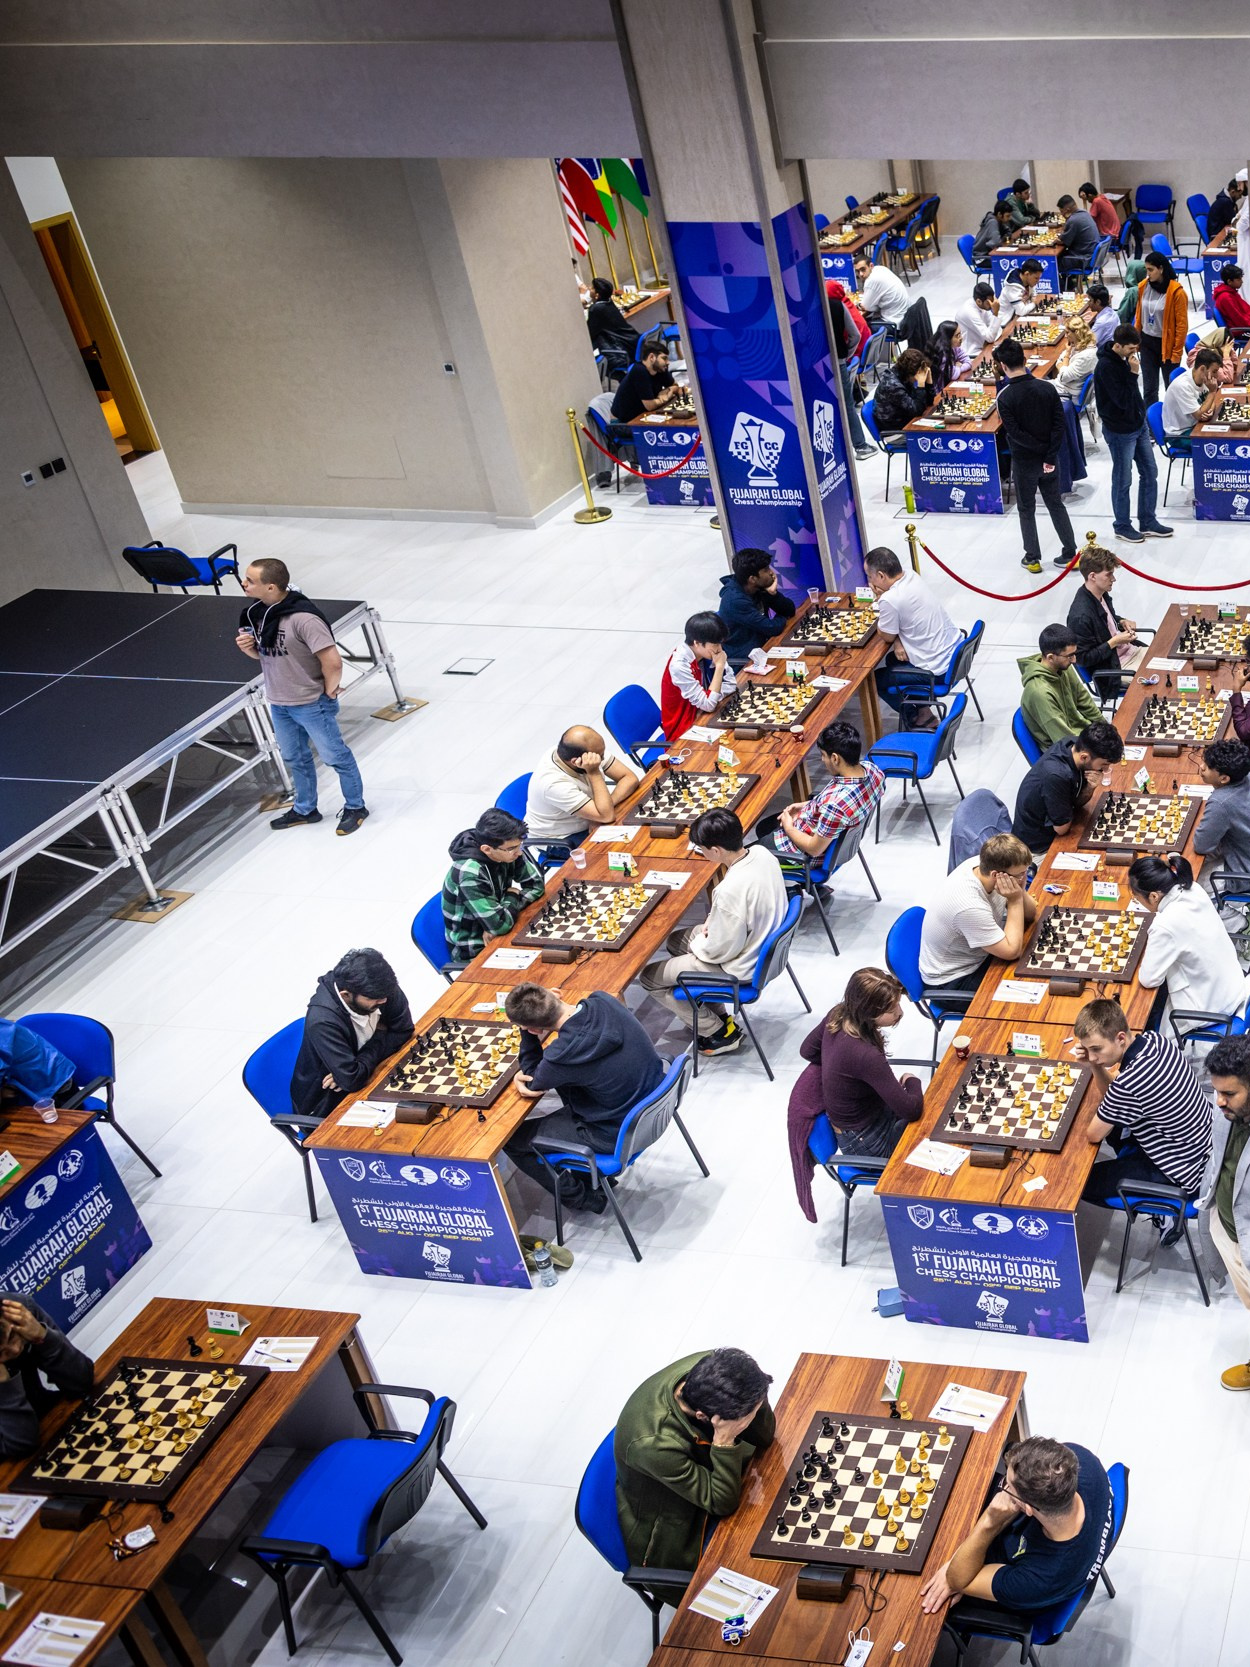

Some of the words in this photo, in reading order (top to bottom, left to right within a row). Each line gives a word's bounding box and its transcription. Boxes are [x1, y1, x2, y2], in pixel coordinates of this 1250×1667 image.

[734, 442, 748, 450] FG
[930, 467, 962, 477] FUJAIRAH
[963, 468, 990, 478] GLOBAL
[1204, 474, 1212, 482] 1ST
[1214, 474, 1247, 484] FUJAIRAH
[729, 488, 770, 499] FUJAIRAH
[772, 489, 805, 500] GLOBAL
[756, 498, 802, 507] Championship
[406, 1202, 434, 1210] العالمية
[436, 1204, 462, 1212] الفجيرة
[354, 1204, 370, 1218] 1ST
[373, 1206, 438, 1226] FUJAIRAH
[438, 1212, 493, 1230] GLOBAL
[360, 1219, 399, 1230] CHESS
[401, 1222, 494, 1238] CHAMPIONSHIP
[10, 1229, 68, 1291] FUJAIRAH
[66, 1190, 111, 1238] GLOBAL
[38, 1203, 114, 1280] CHAMPIONSHIP
[912, 1245, 946, 1254] للشطرنج
[970, 1250, 1002, 1260] العالمية
[1002, 1253, 1032, 1262] الفجيرة
[912, 1252, 930, 1266] 1ST
[933, 1254, 1002, 1275] FUJAIRAH
[1004, 1262, 1060, 1281] GLOBAL
[1032, 1257, 1058, 1266] بطولة
[916, 1268, 957, 1278] CHESS
[960, 1272, 1061, 1289] CHAMPIONSHIP
